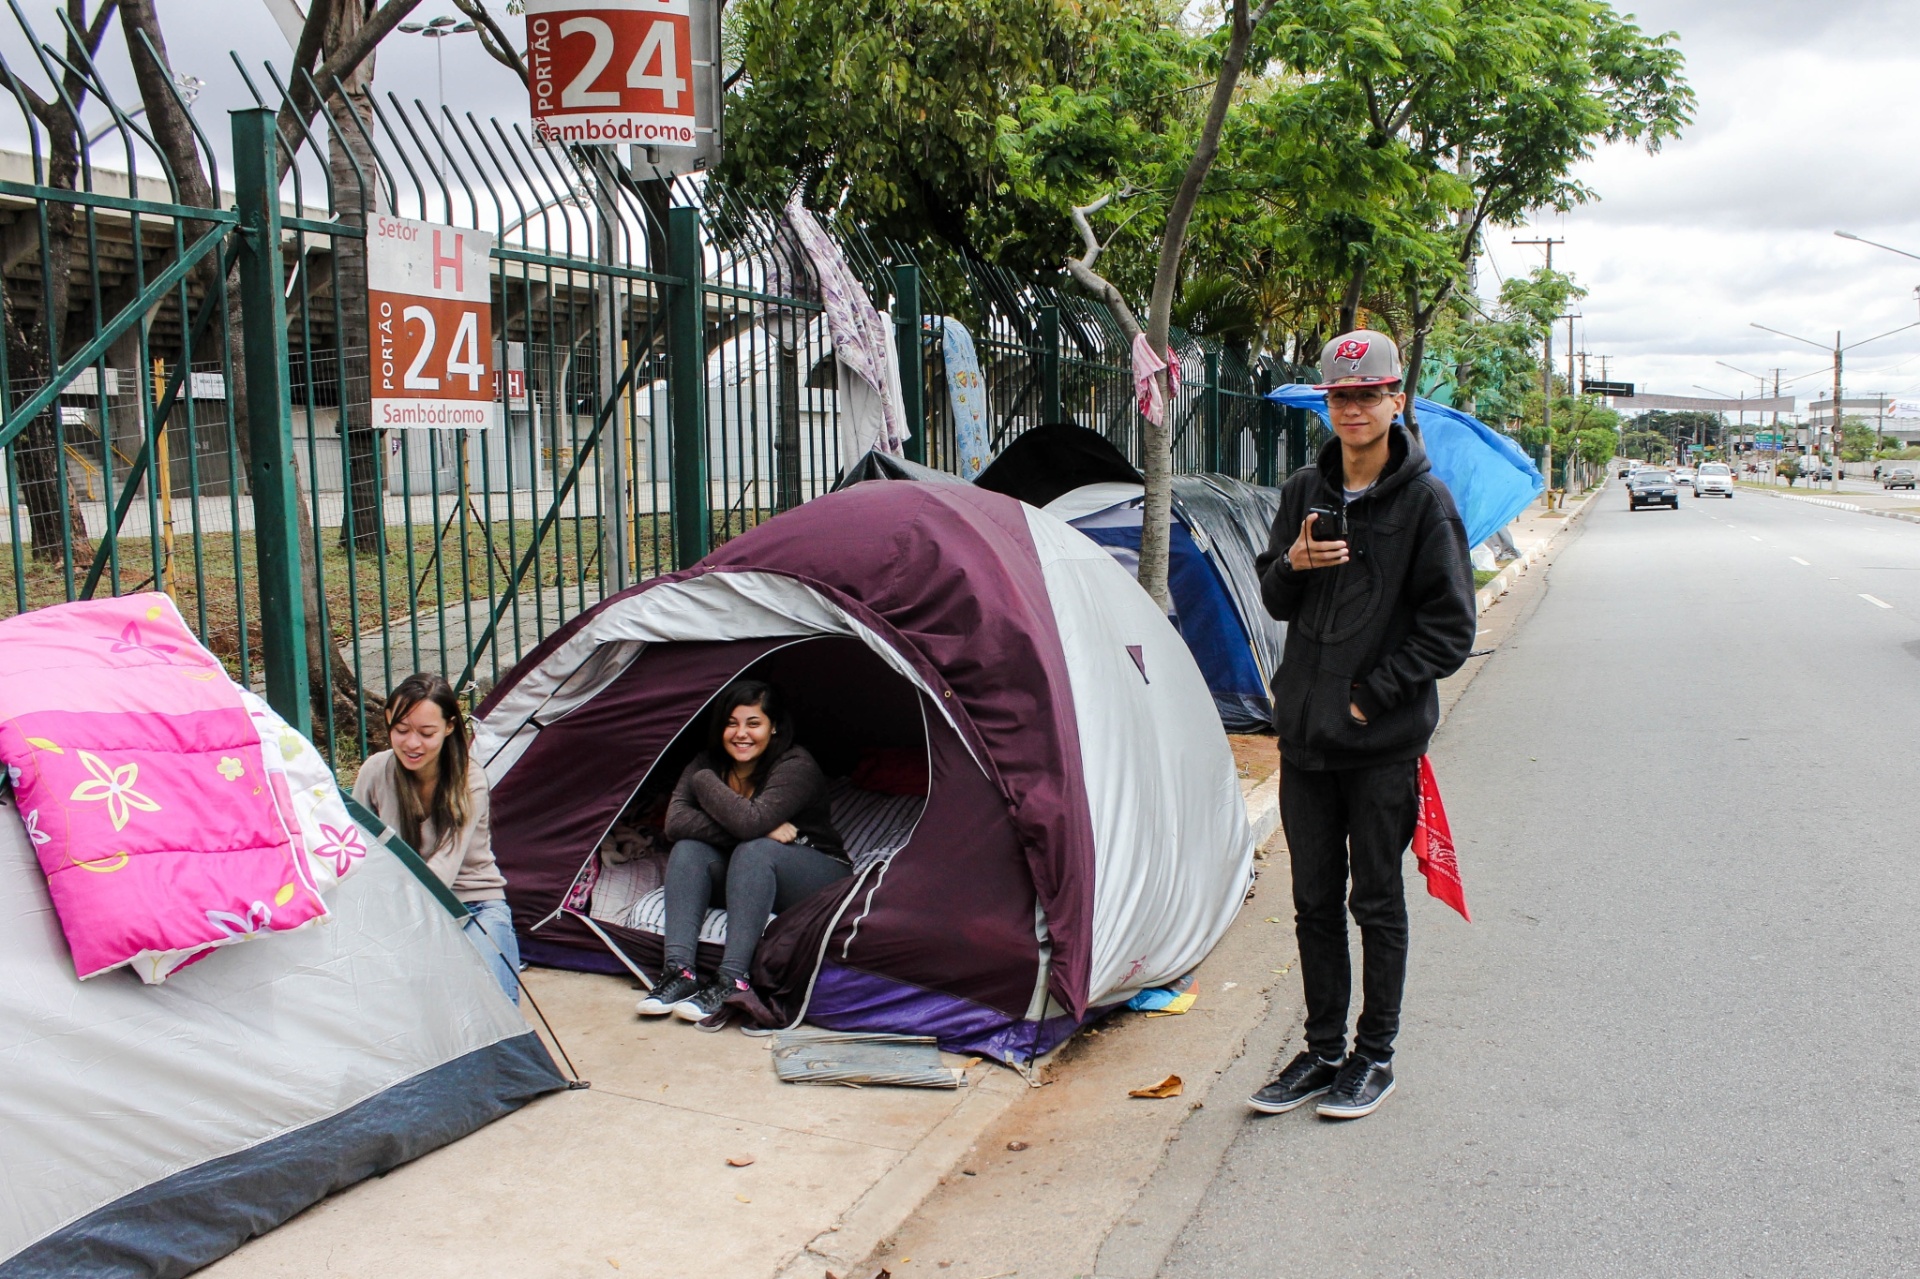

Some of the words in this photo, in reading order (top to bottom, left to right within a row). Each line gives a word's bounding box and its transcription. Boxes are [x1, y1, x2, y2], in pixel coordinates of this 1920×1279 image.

[531, 18, 554, 111] PORTÃO
[559, 16, 687, 109] 24
[378, 217, 418, 241] Setor
[433, 229, 464, 292] H
[378, 301, 395, 390] PORTÃO
[403, 305, 485, 392] 24
[508, 373, 520, 395] H
[383, 403, 485, 424] Sambódromo
